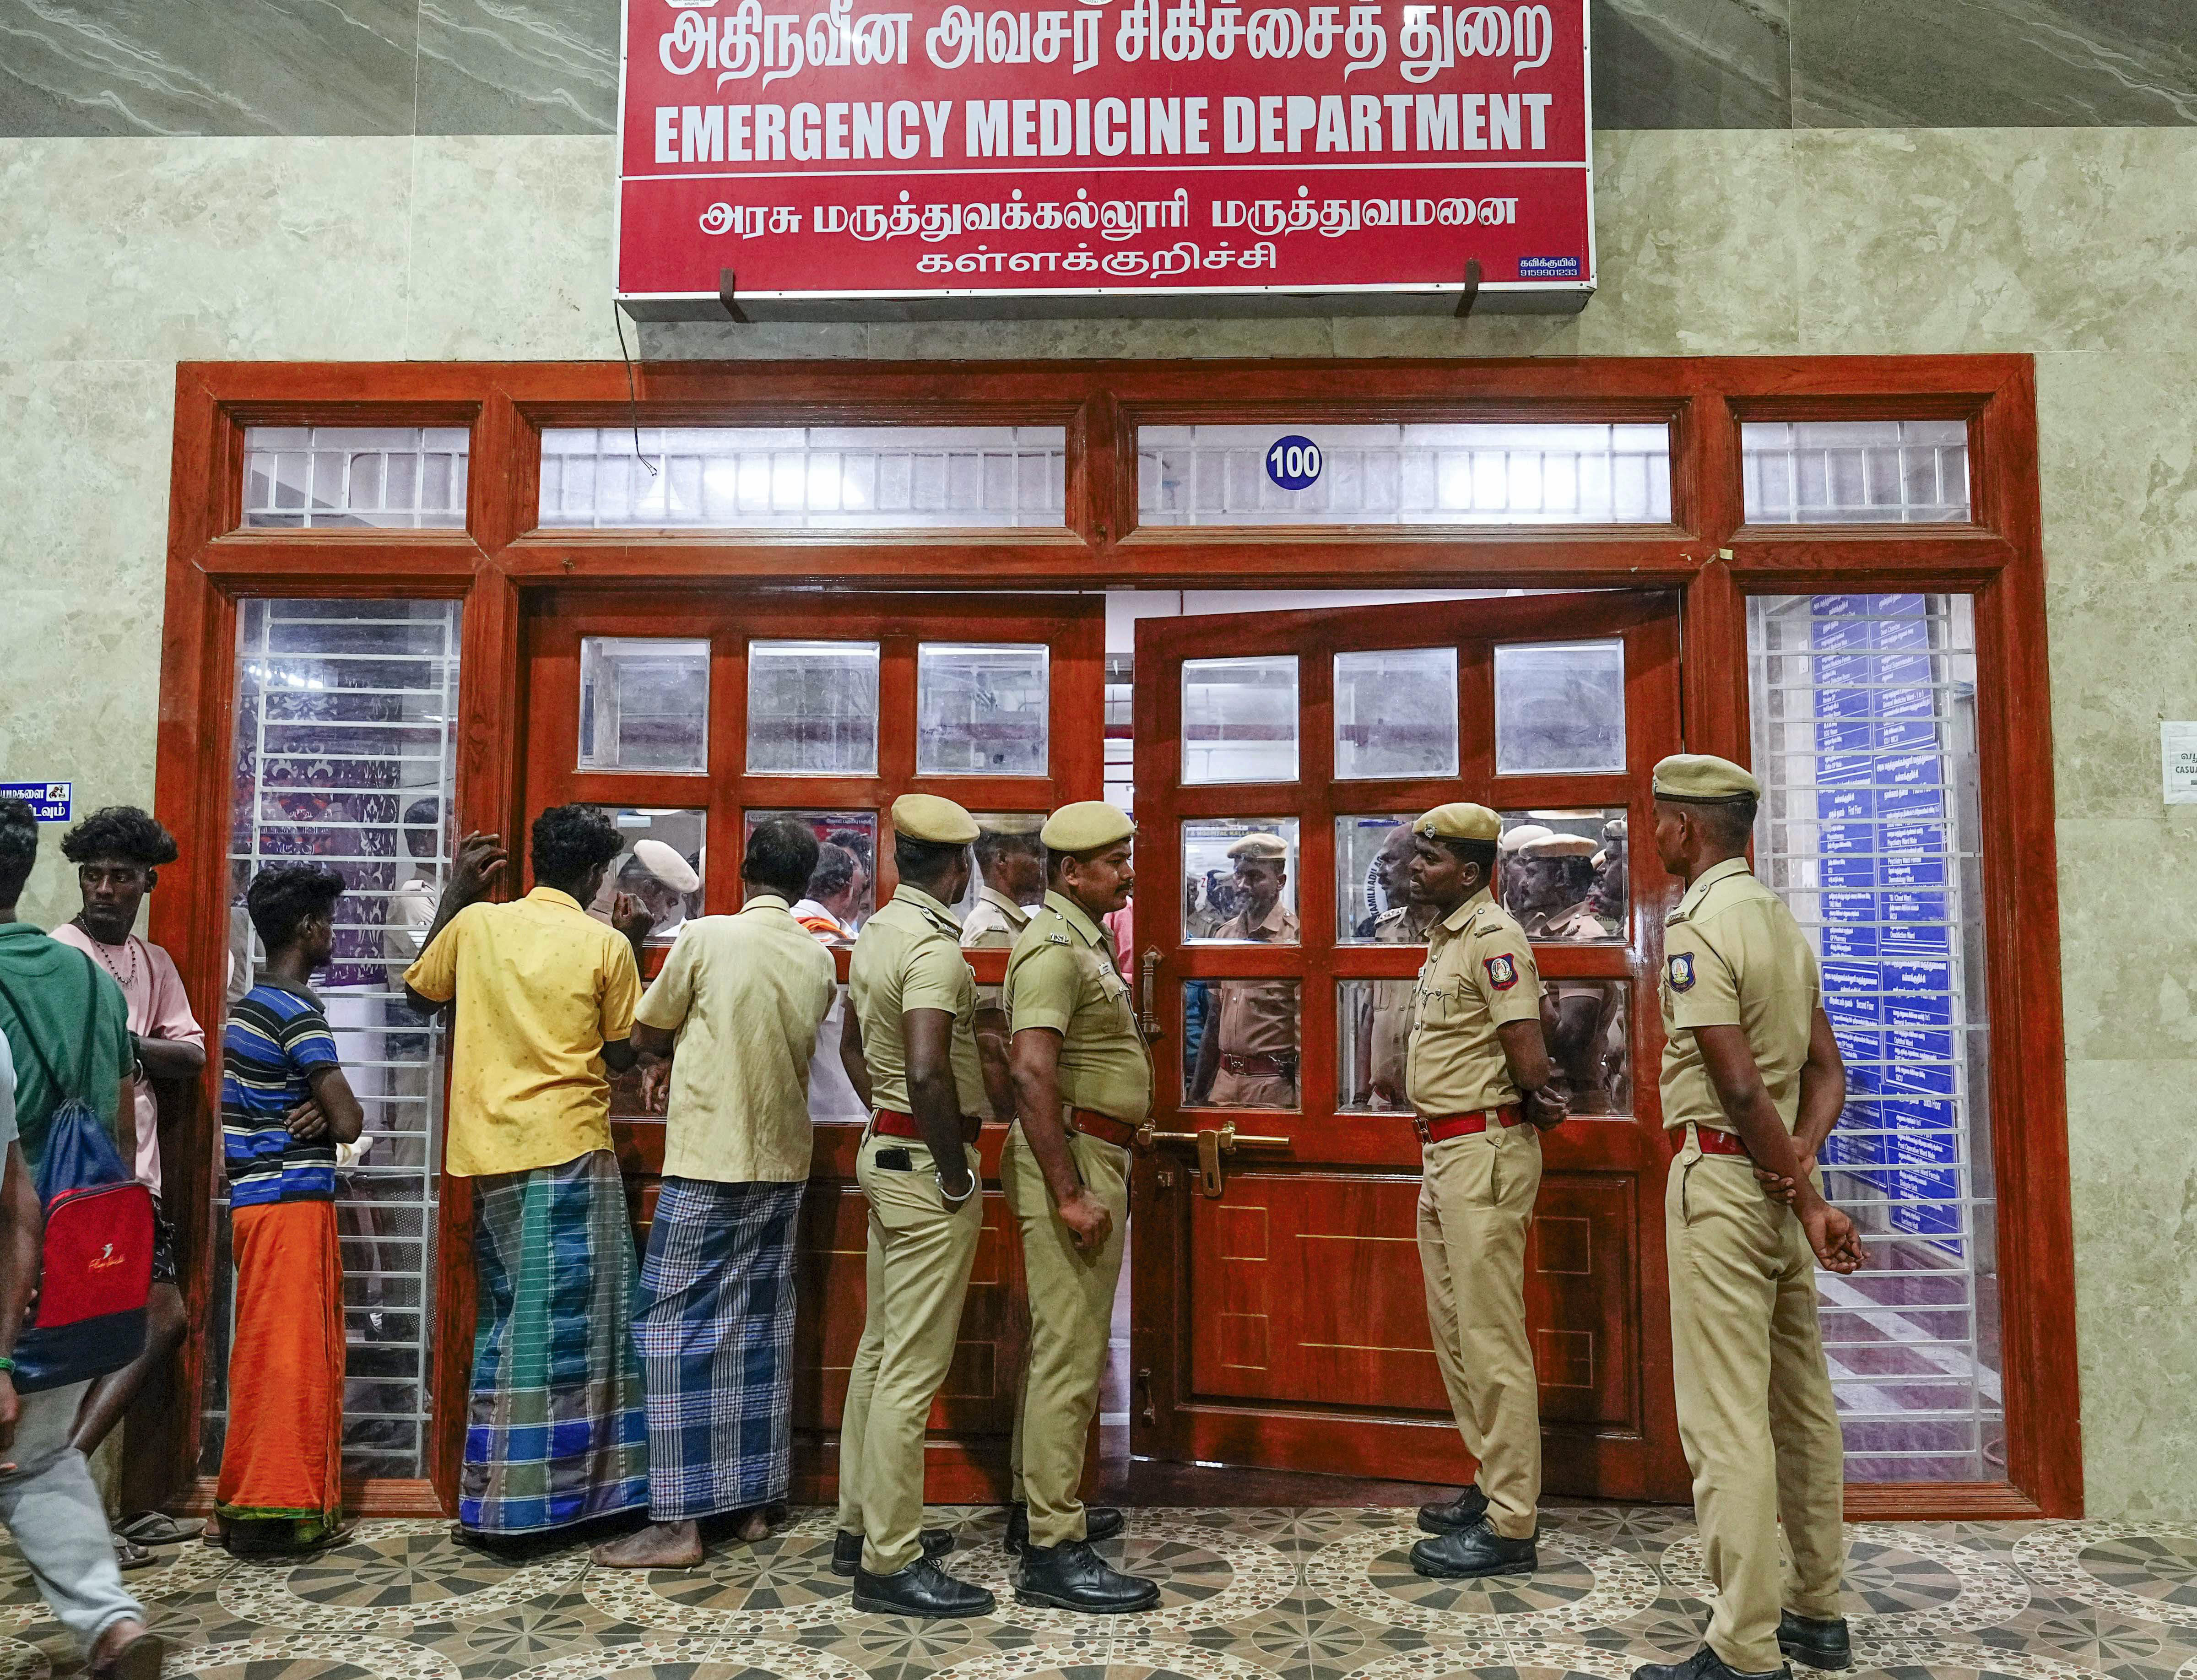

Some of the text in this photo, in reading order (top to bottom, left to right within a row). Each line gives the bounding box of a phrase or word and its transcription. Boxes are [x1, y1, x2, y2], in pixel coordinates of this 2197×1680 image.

[659, 0, 913, 93] அதிநவீன
[926, 5, 1102, 75] அவசர
[1400, 5, 1552, 83] துறை
[655, 94, 1552, 163] EMERGENCY MEDICINE DEPARTMENT
[699, 186, 1518, 242] அரசு மருத்துவக்கல்லூரி மருத்துவமனை
[917, 242, 1276, 278] கள்ளக்குறிச்சி
[1520, 258, 1577, 268] கவிக்குயில்
[1271, 446, 1320, 477] 100
[28, 802, 65, 818] டவும்
